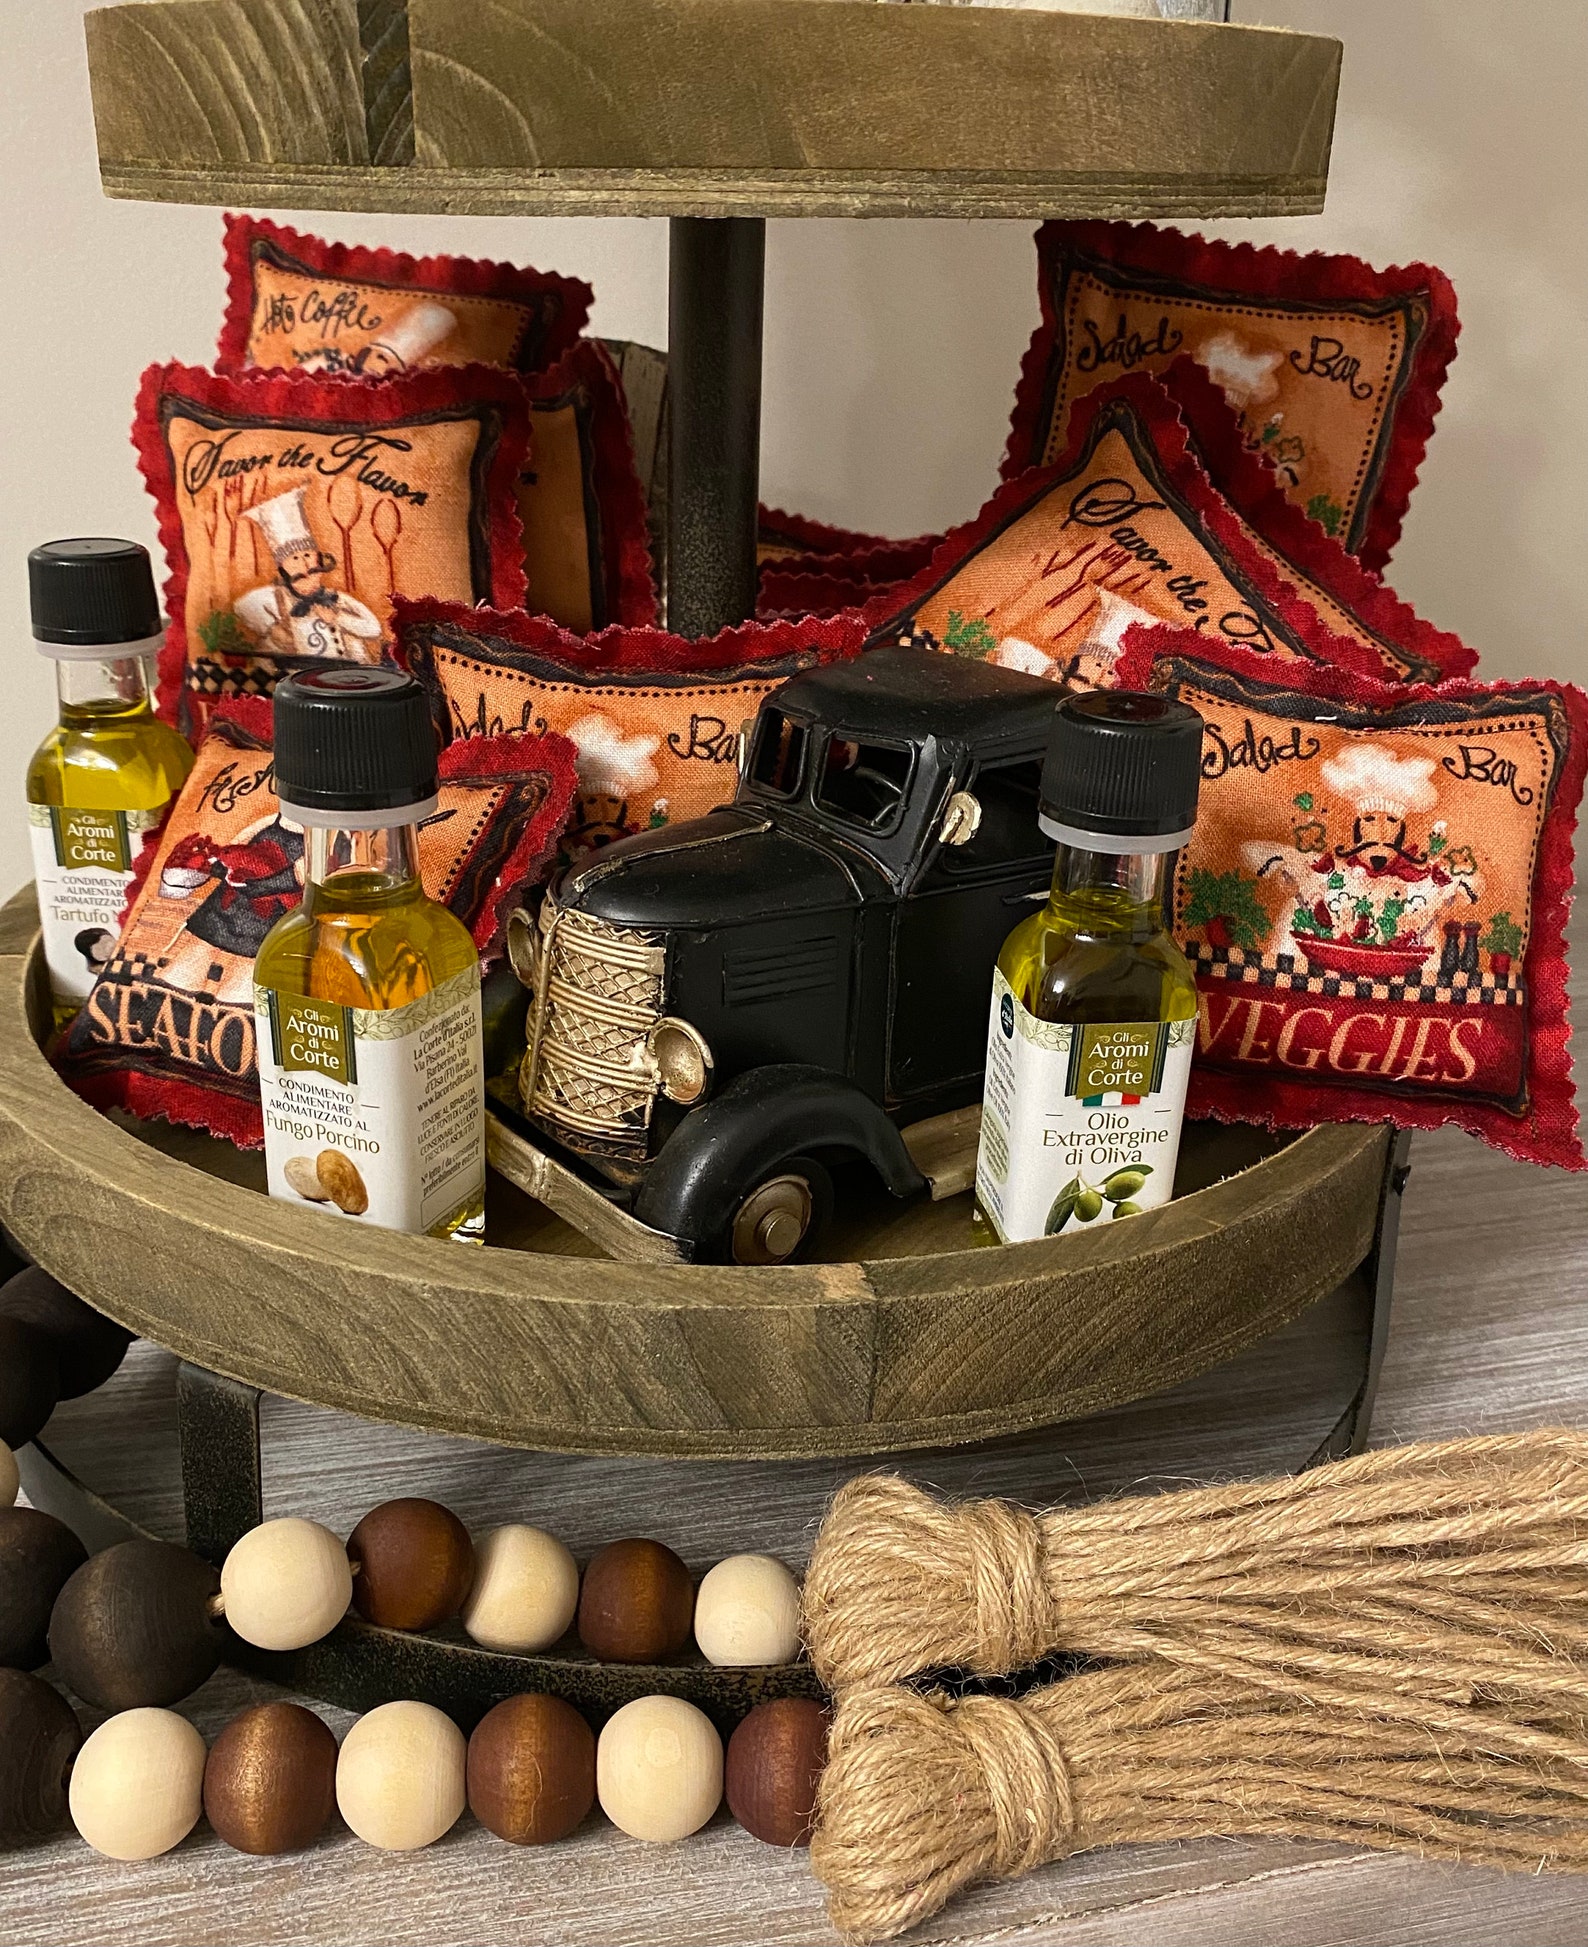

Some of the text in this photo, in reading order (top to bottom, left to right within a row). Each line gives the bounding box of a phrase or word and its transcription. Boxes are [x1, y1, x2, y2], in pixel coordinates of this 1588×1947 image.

[300, 290, 382, 339] Coffee
[1076, 314, 1372, 400] Salad Bar
[183, 431, 428, 507] Savor the Flavor
[1060, 478, 1208, 613] Savor the
[667, 713, 739, 765] Ba
[1201, 719, 1533, 806] Salad Bar
[67, 823, 115, 839] Aromi
[82, 815, 96, 825] Gli
[71, 845, 116, 862] Corte
[87, 839, 97, 848] di
[66, 886, 124, 897] ALIMENTAR
[50, 905, 109, 924] Tartufo
[304, 1008, 319, 1022] Gli
[88, 981, 258, 1078] SEAFO
[286, 1015, 339, 1042] Aromi
[1112, 1032, 1129, 1043] Gli
[1198, 991, 1483, 1083] VEGGIES
[309, 1037, 319, 1049] di
[413, 1048, 423, 1061] La
[423, 1036, 442, 1055] Corte
[1088, 1041, 1149, 1058] Aromi
[290, 1043, 340, 1070] Corte
[413, 1059, 426, 1073] Via
[426, 1053, 457, 1080] Barberino
[1111, 1059, 1123, 1070] di
[1088, 1069, 1143, 1086] Corte
[278, 1077, 355, 1104] CONDIMENTO
[283, 1091, 353, 1116] ALIMENTARE
[269, 1099, 371, 1132] AROMATIZZATO AL
[1088, 1112, 1129, 1130] Olio
[266, 1109, 380, 1154] Fungo Porcino
[1043, 1127, 1169, 1149] Extravergine
[1065, 1147, 1142, 1165] di Oliva
